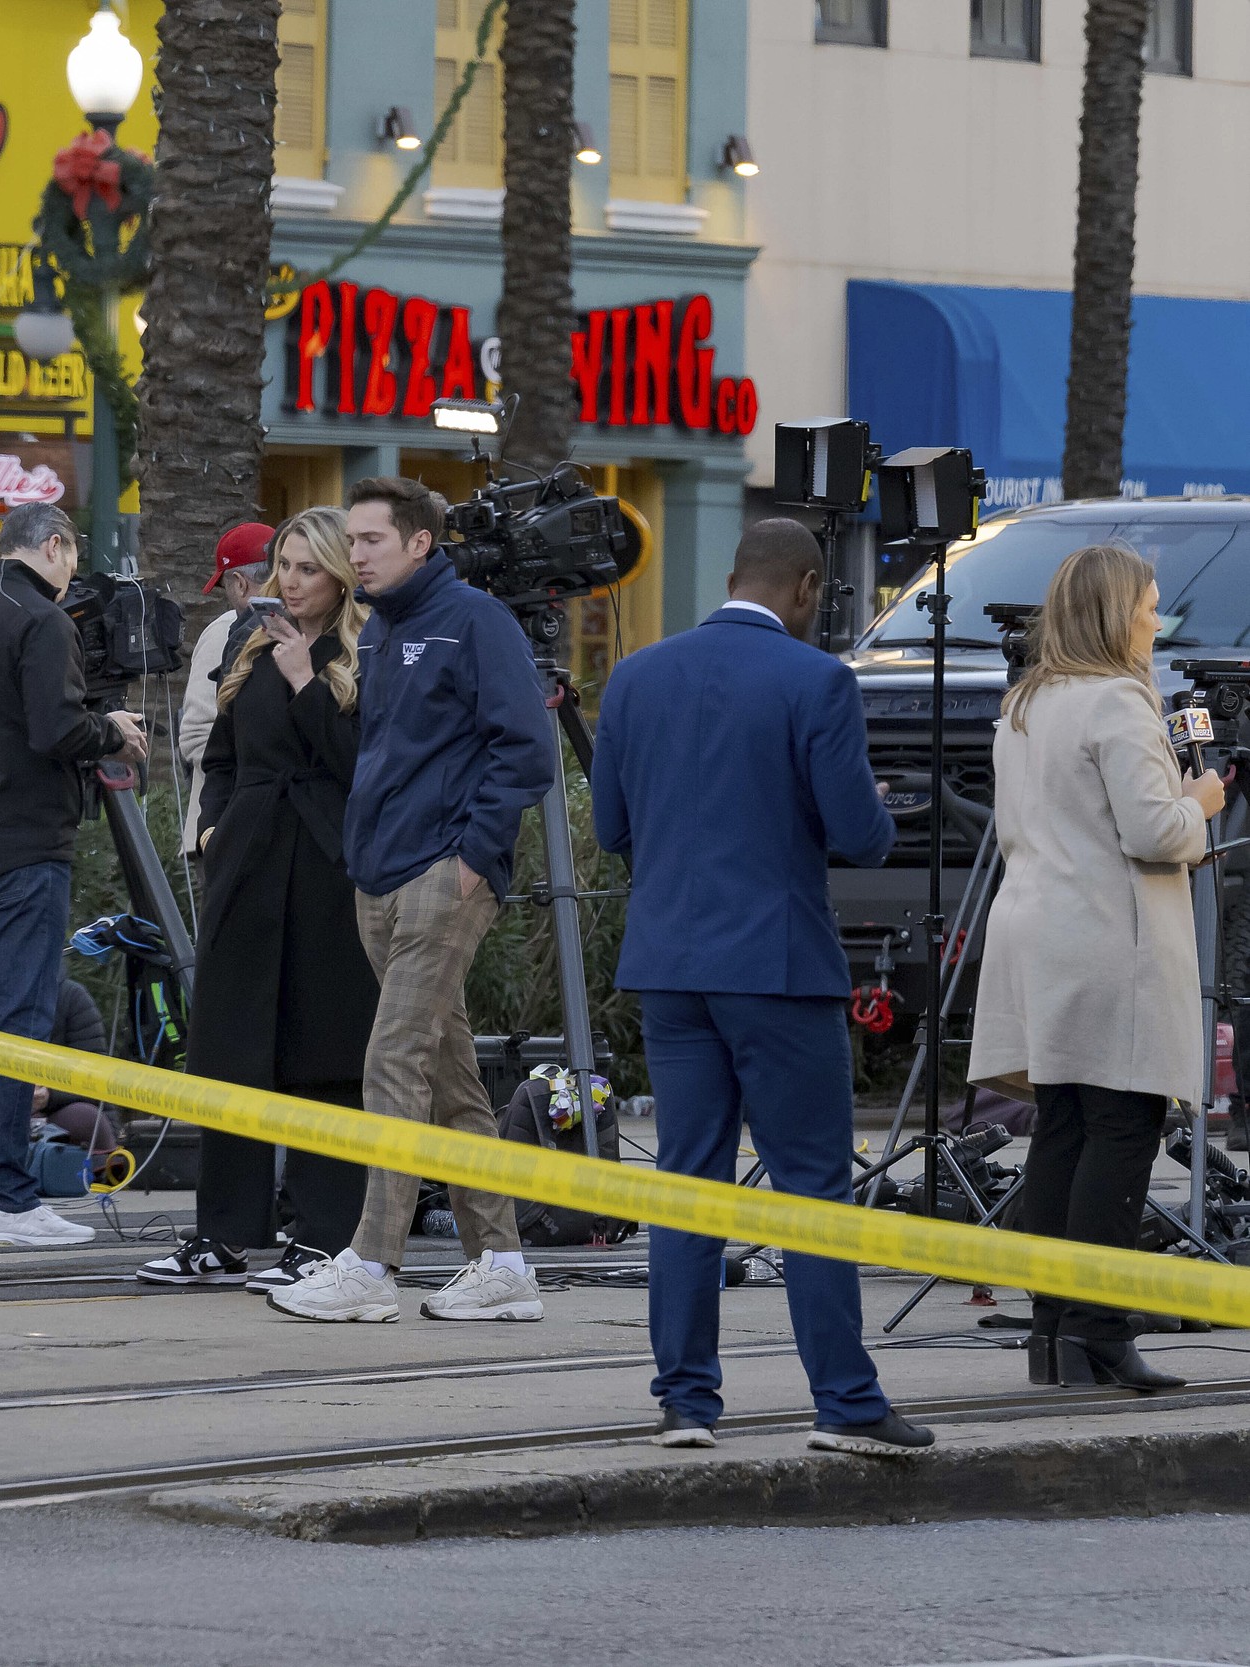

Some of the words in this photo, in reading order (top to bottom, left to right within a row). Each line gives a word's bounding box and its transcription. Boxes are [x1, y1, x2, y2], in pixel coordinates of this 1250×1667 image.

[296, 279, 476, 418] PIZZA
[983, 476, 1042, 507] OURIST
[403, 654, 414, 665] 22
[1170, 714, 1184, 735] 2
[1191, 711, 1206, 729] 2
[1171, 731, 1190, 743] WBRZ
[1193, 729, 1211, 737] WBRZ
[883, 792, 917, 806] ord
